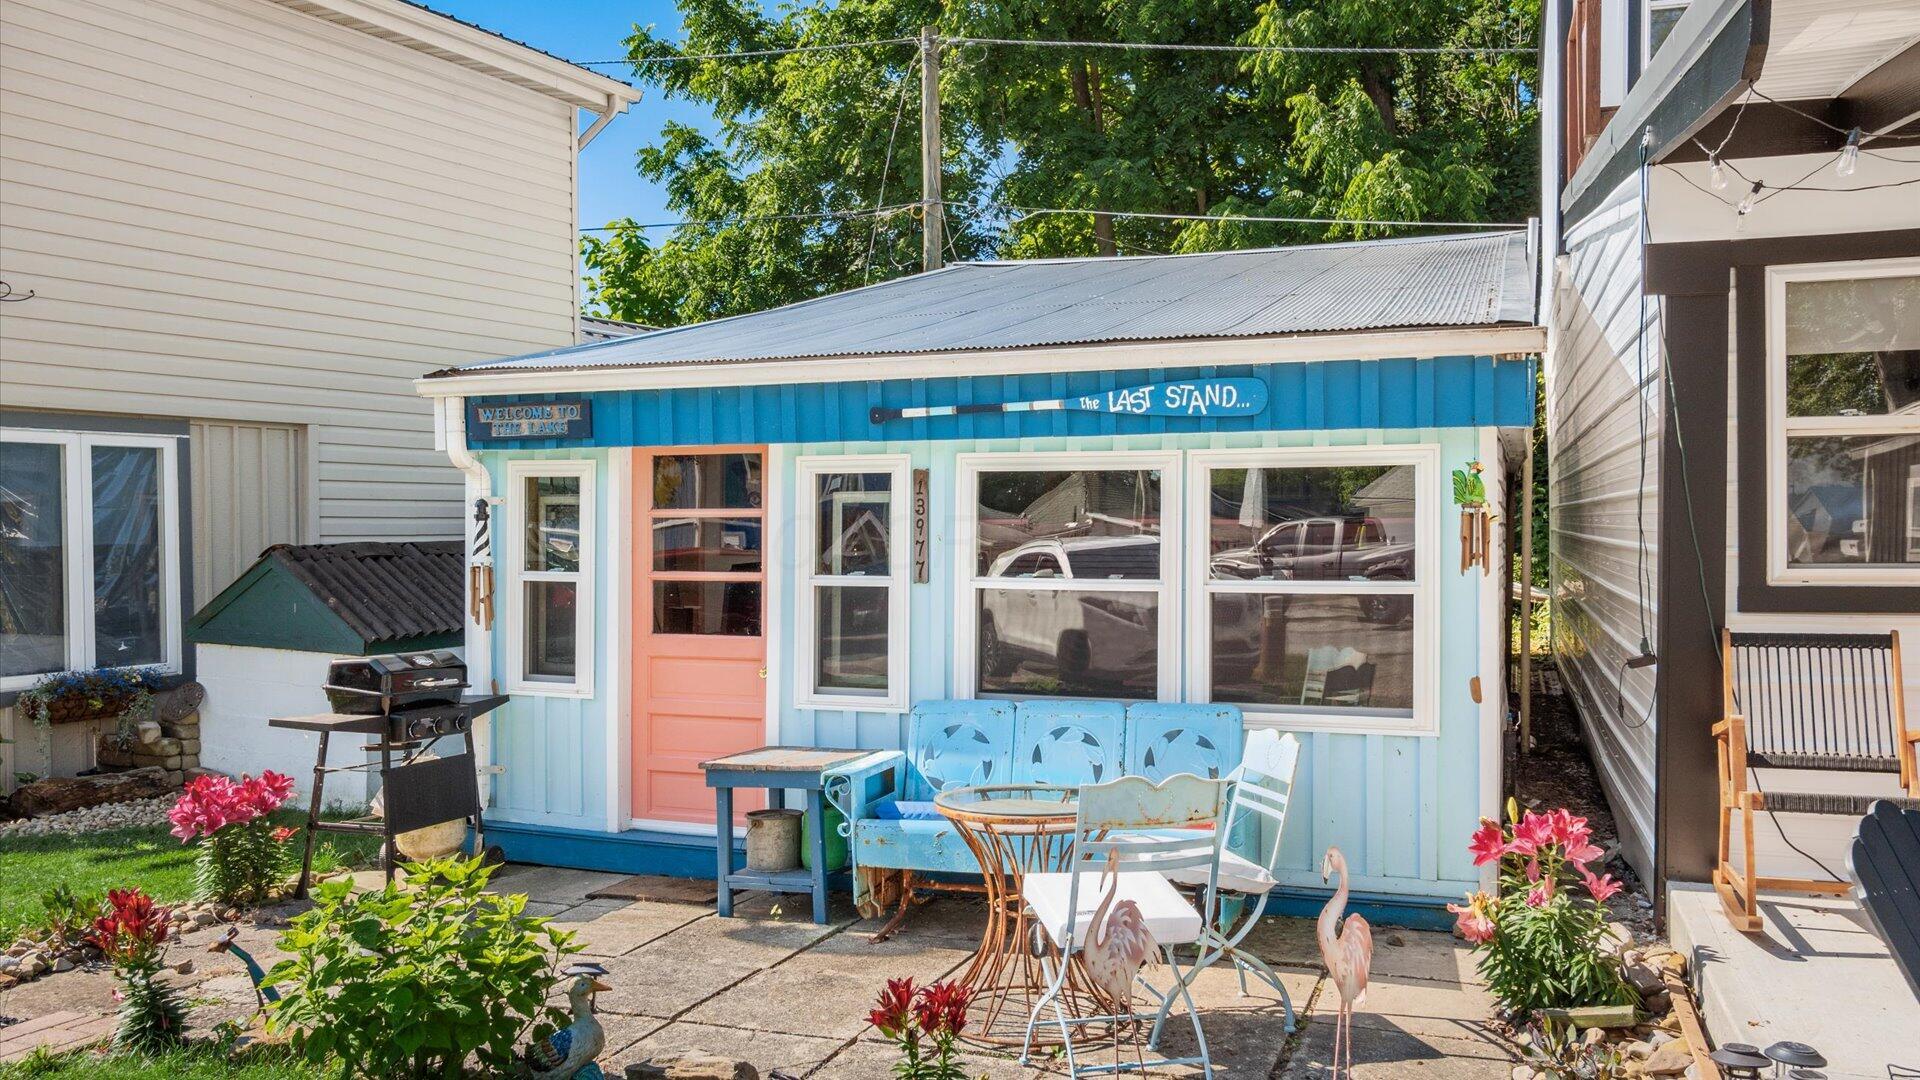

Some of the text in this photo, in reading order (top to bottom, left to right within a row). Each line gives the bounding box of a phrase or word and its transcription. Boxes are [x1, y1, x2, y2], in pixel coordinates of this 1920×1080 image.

[1079, 383, 1250, 415] the LAST STAND...
[482, 404, 577, 420] WELCOME TO
[493, 420, 568, 435] THE LAKE
[914, 479, 926, 579] 13977
